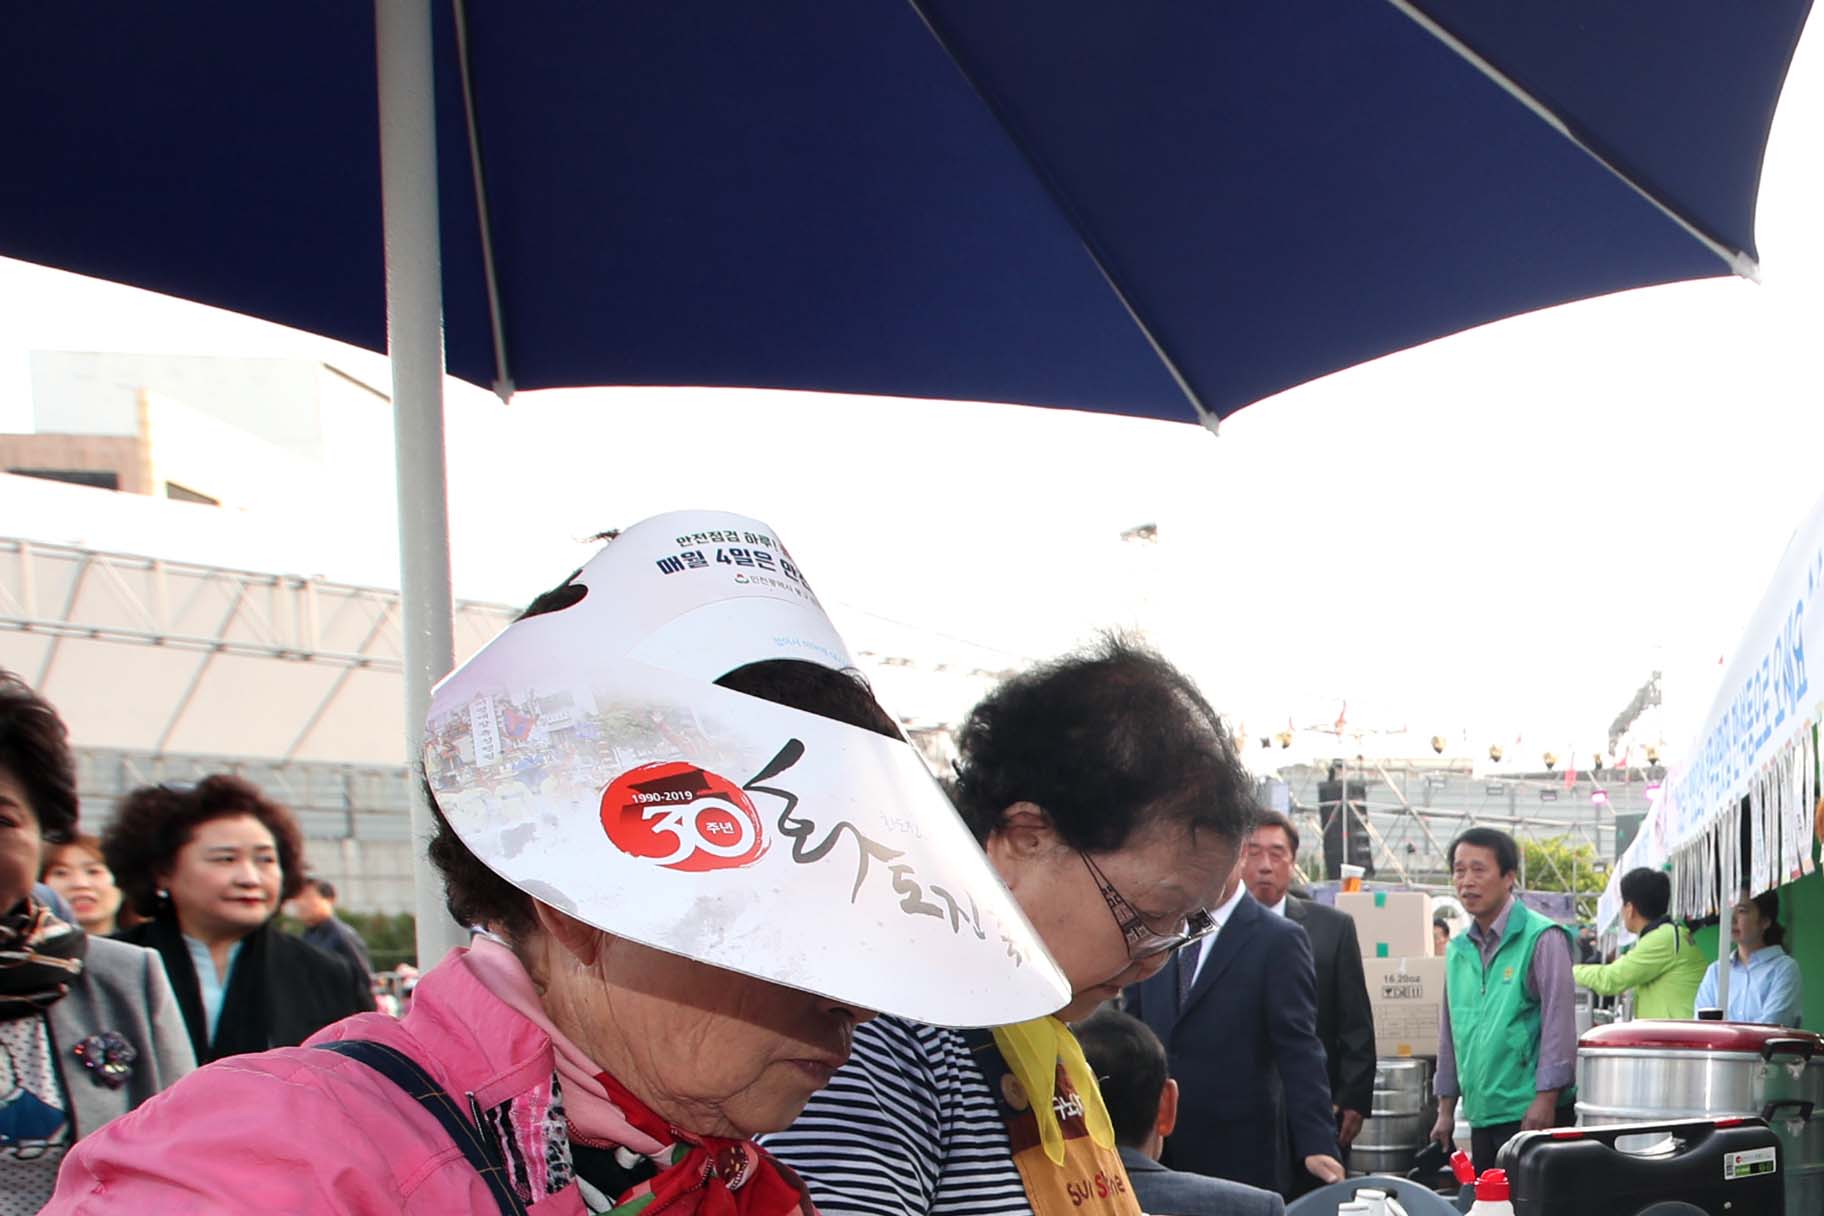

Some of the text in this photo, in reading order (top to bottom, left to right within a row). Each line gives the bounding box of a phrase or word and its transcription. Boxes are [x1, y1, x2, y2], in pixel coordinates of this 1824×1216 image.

[676, 530, 740, 547] 안전점검
[656, 549, 709, 575] 매월
[716, 548, 776, 572] 4일은
[632, 790, 693, 804] 1990-2019
[641, 796, 756, 866] 30
[706, 821, 735, 834] 주년
